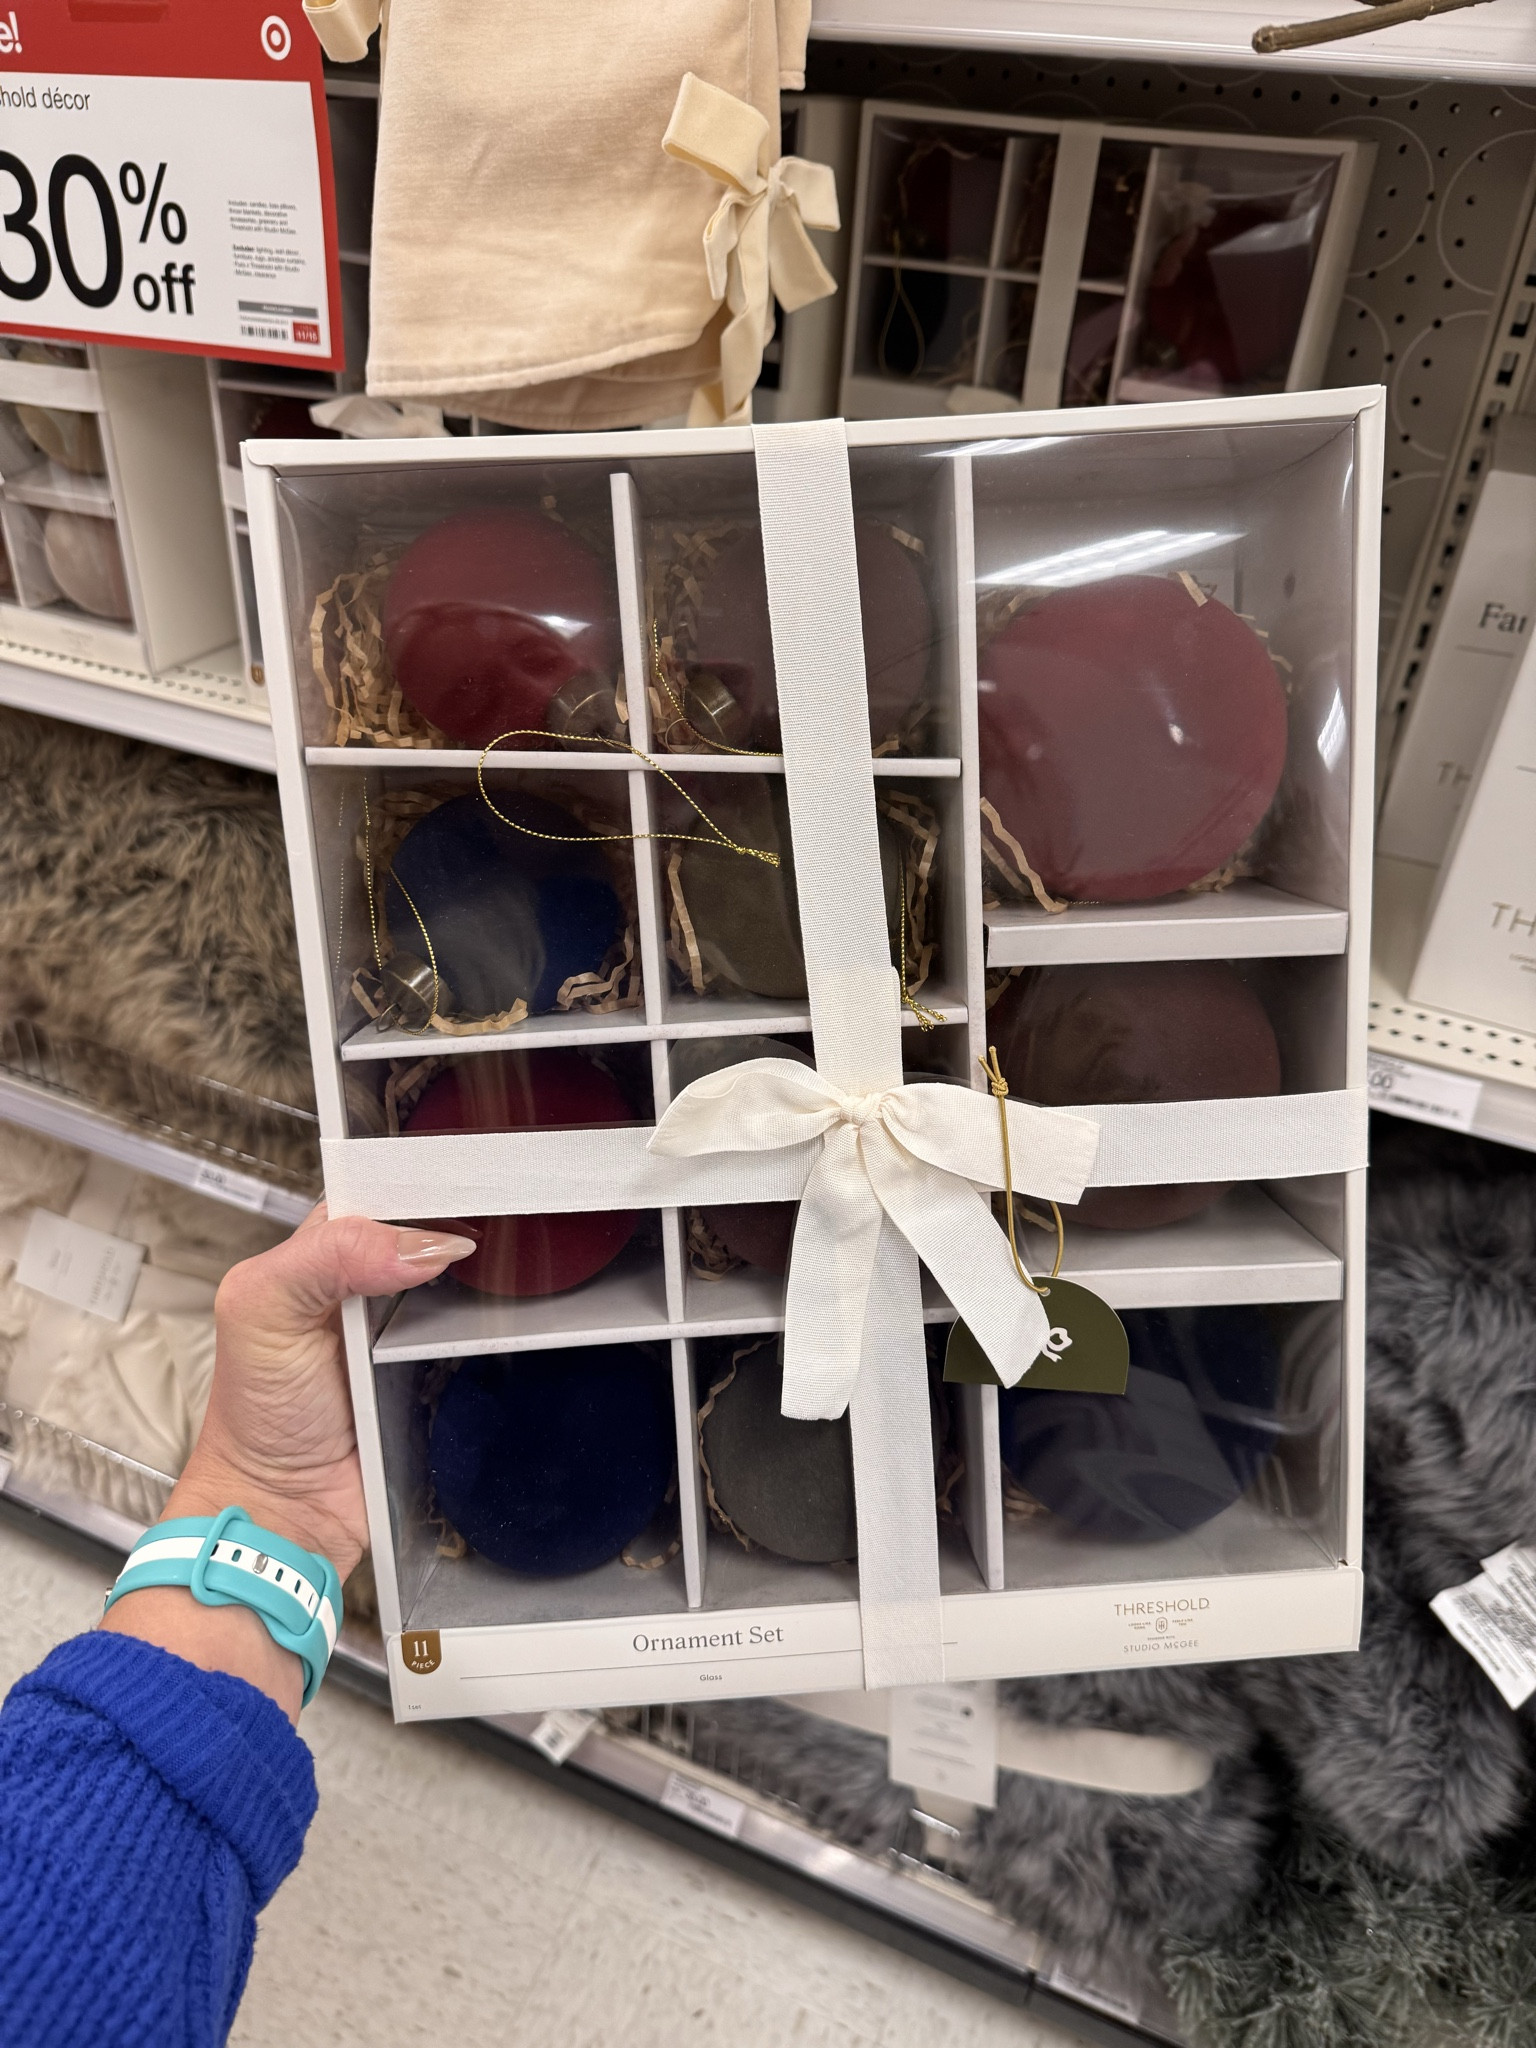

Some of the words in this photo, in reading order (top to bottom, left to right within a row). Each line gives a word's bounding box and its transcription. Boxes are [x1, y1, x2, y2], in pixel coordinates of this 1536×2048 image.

[0, 85, 37, 108] hold
[42, 87, 90, 110] décor
[133, 262, 195, 315] off
[1114, 1597, 1209, 1616] THRESHOLD
[632, 1630, 744, 1652] Ornament
[749, 1625, 785, 1645] Set
[1123, 1642, 1160, 1653] STUDIO
[413, 1640, 429, 1657] 11
[411, 1659, 436, 1669] PIECE
[699, 1674, 723, 1682] Glass
